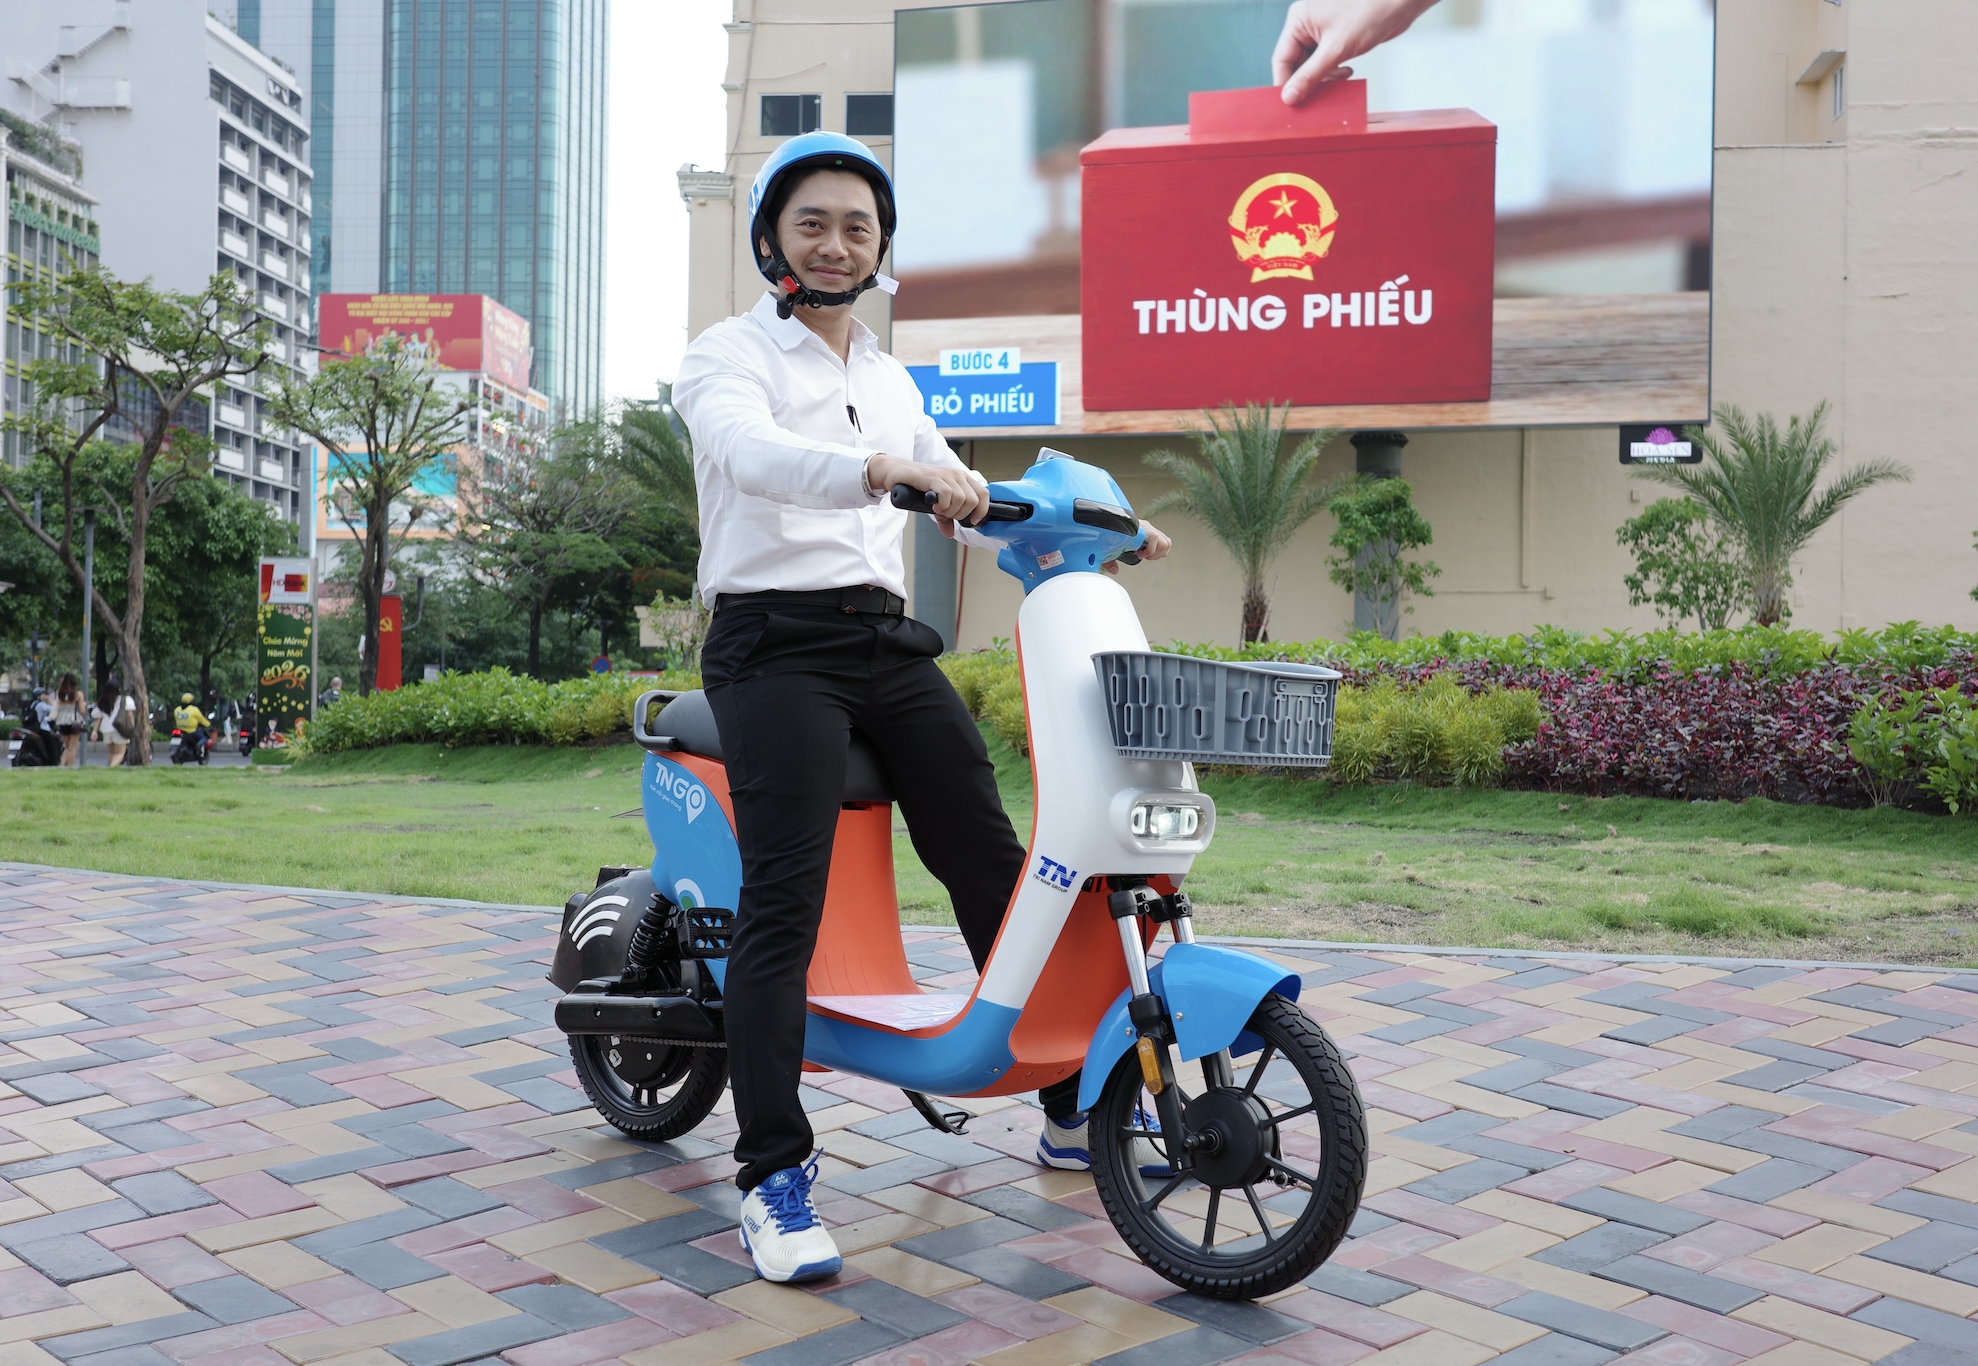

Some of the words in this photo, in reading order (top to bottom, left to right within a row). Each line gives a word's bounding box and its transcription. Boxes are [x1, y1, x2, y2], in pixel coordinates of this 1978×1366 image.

[1133, 287, 1287, 334] THÙNG
[1303, 274, 1432, 328] PHIẾU
[951, 351, 992, 370] BƯỚC
[998, 351, 1009, 369] 4
[931, 387, 962, 415] BỎ
[970, 383, 1034, 413] PHIẾU
[1632, 445, 1660, 456] HOA
[272, 579, 306, 588] HDBank
[263, 659, 311, 684] 2026
[1038, 855, 1077, 888] TN
[1040, 878, 1051, 886] NAM
